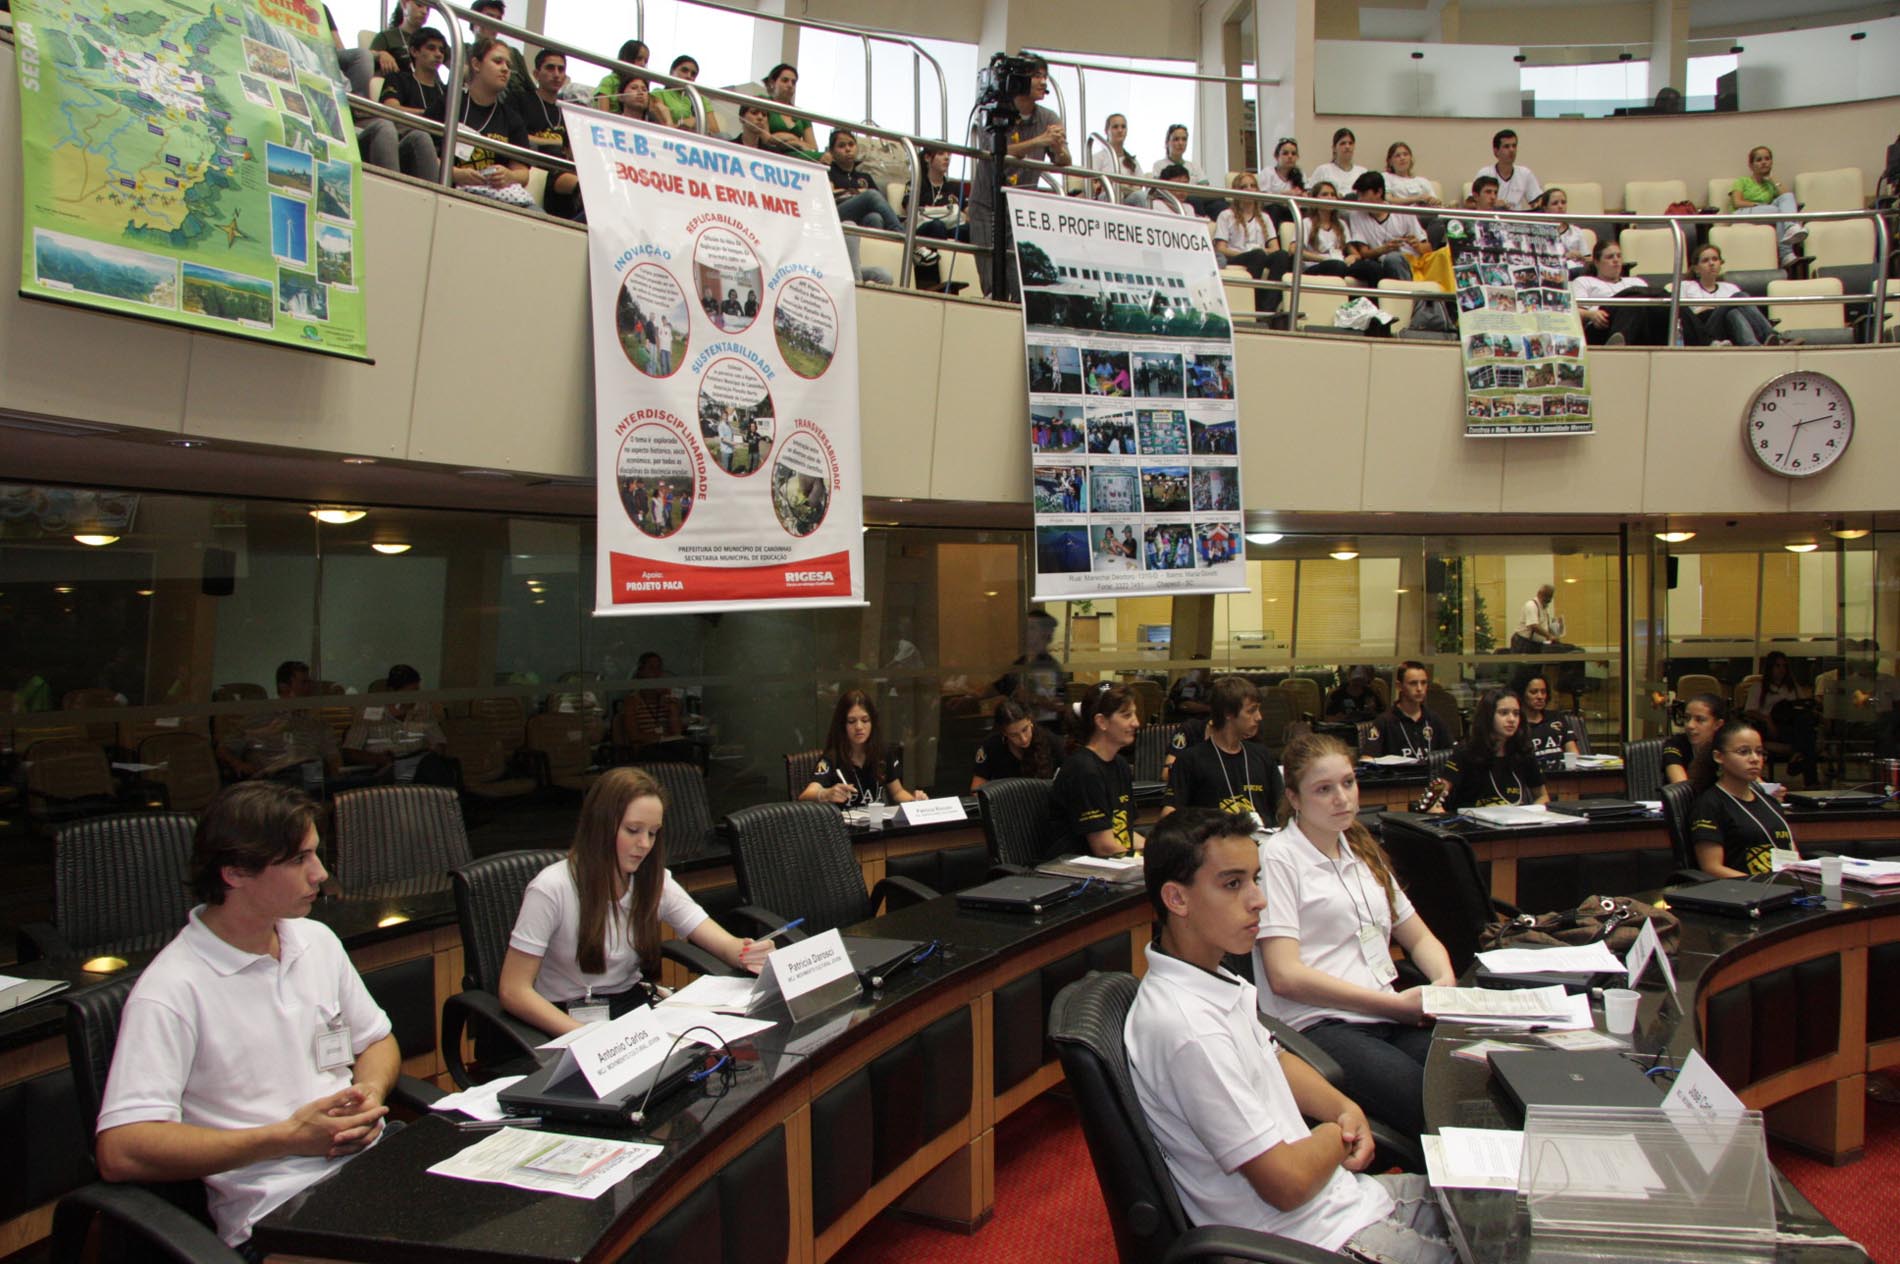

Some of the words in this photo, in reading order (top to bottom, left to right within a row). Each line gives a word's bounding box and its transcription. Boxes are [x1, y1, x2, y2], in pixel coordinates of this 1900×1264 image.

[16, 22, 40, 92] SERRA
[591, 126, 656, 157] E.E.B.
[615, 162, 684, 194] BOSQUE
[688, 179, 711, 200] DA
[715, 184, 758, 208] ERVA
[761, 193, 800, 217] MATE
[686, 213, 761, 246] REPLICABILIDADE
[1015, 209, 1055, 232] E.E.B.
[1104, 222, 1143, 244] IRENE
[1147, 228, 1211, 251] STONOGA
[691, 341, 776, 380] SUSTENTABILIDADE
[1792, 382, 1807, 391] 12
[1775, 388, 1786, 398] 11
[1815, 388, 1821, 397] 1
[1761, 402, 1777, 412] 10
[1828, 402, 1837, 411] 2
[1755, 421, 1764, 430] 9
[1833, 420, 1841, 429] 3
[1760, 440, 1769, 449] 8
[1825, 439, 1835, 448] 4
[615, 408, 708, 501] INTERDISCIPLINARIDADE
[1775, 453, 1784, 462] 7
[1812, 453, 1820, 462] 5
[1792, 458, 1801, 468] 6
[785, 571, 834, 582] RIGESA
[626, 581, 661, 591] PROJETO
[663, 580, 684, 590] PACA
[597, 1041, 626, 1063] Antonio
[624, 1030, 649, 1047] Carlos
